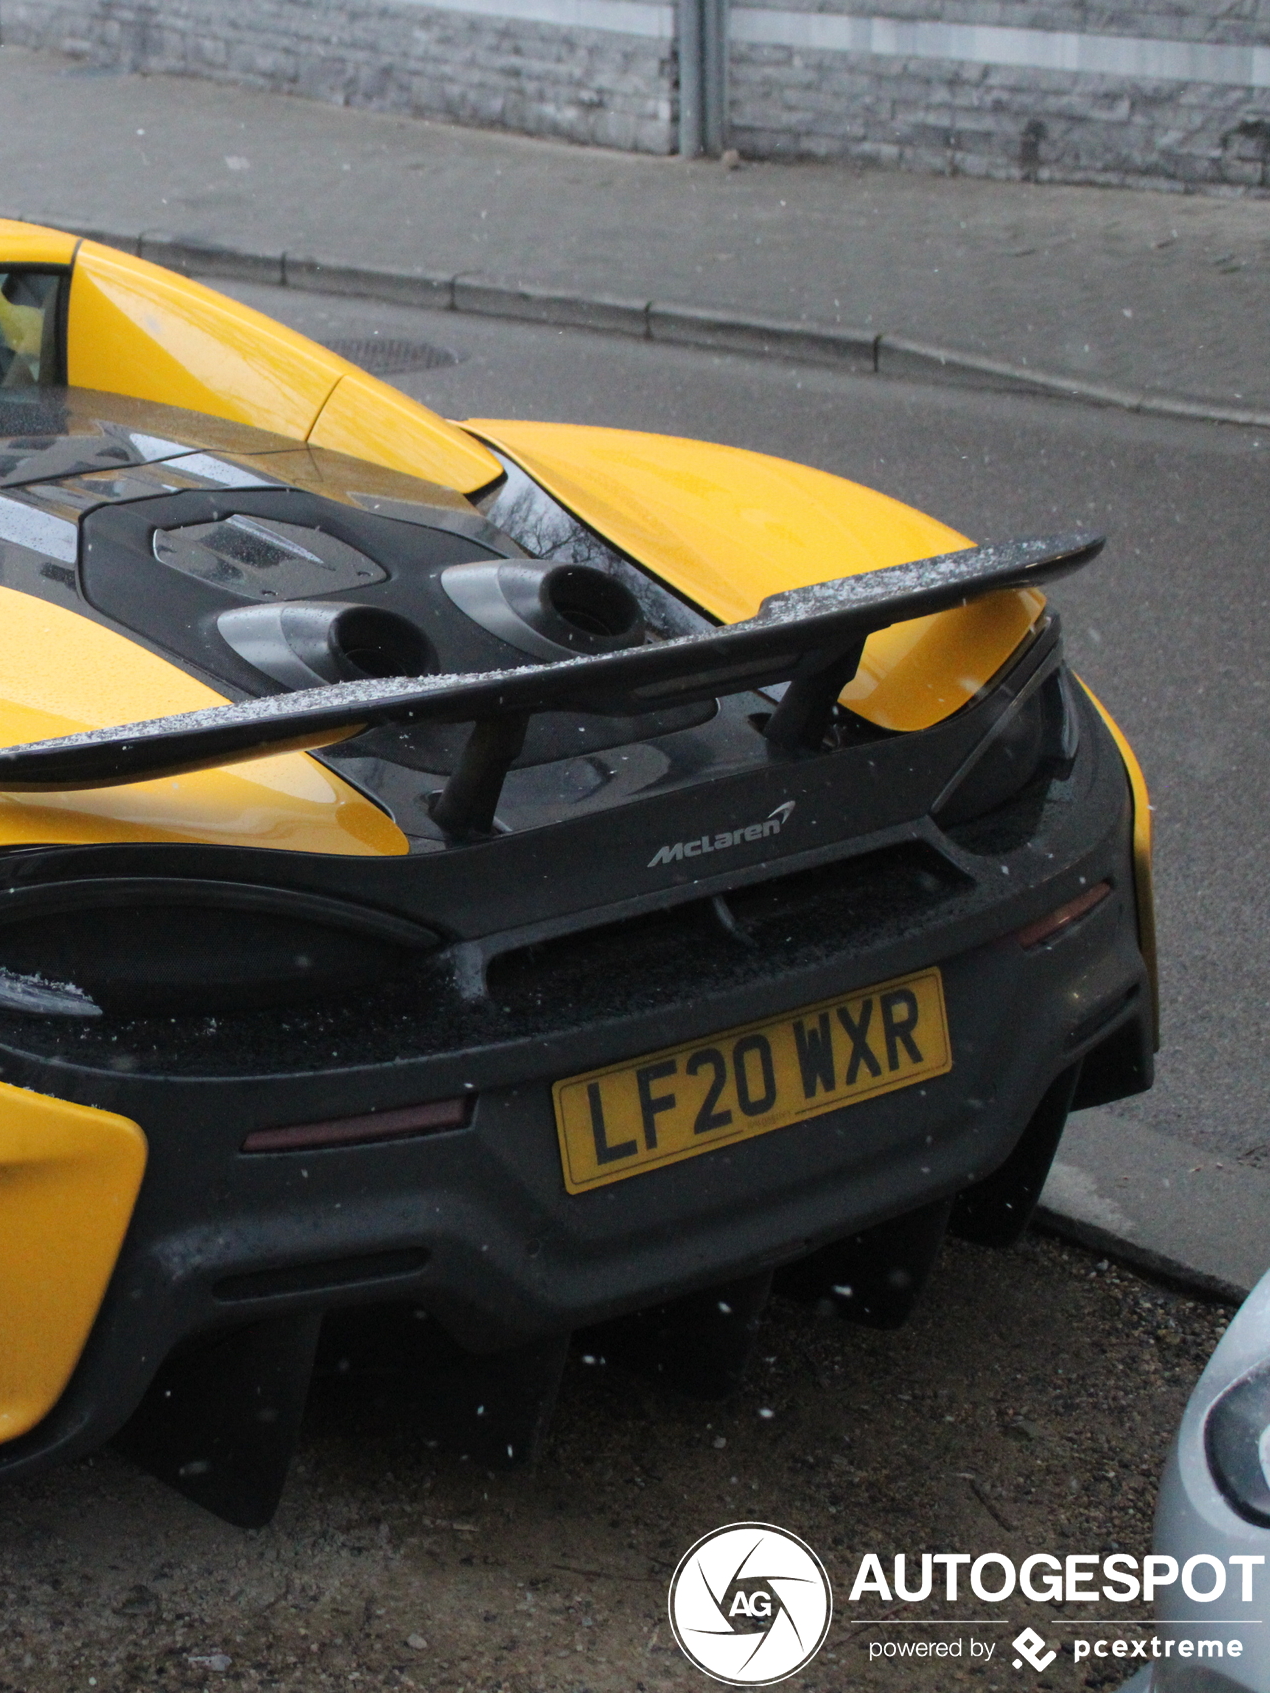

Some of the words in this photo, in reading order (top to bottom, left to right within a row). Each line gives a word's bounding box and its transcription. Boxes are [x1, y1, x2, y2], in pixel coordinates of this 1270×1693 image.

[647, 819, 781, 868] McLaren
[587, 1034, 776, 1166] LF20
[792, 988, 924, 1100] WXR
